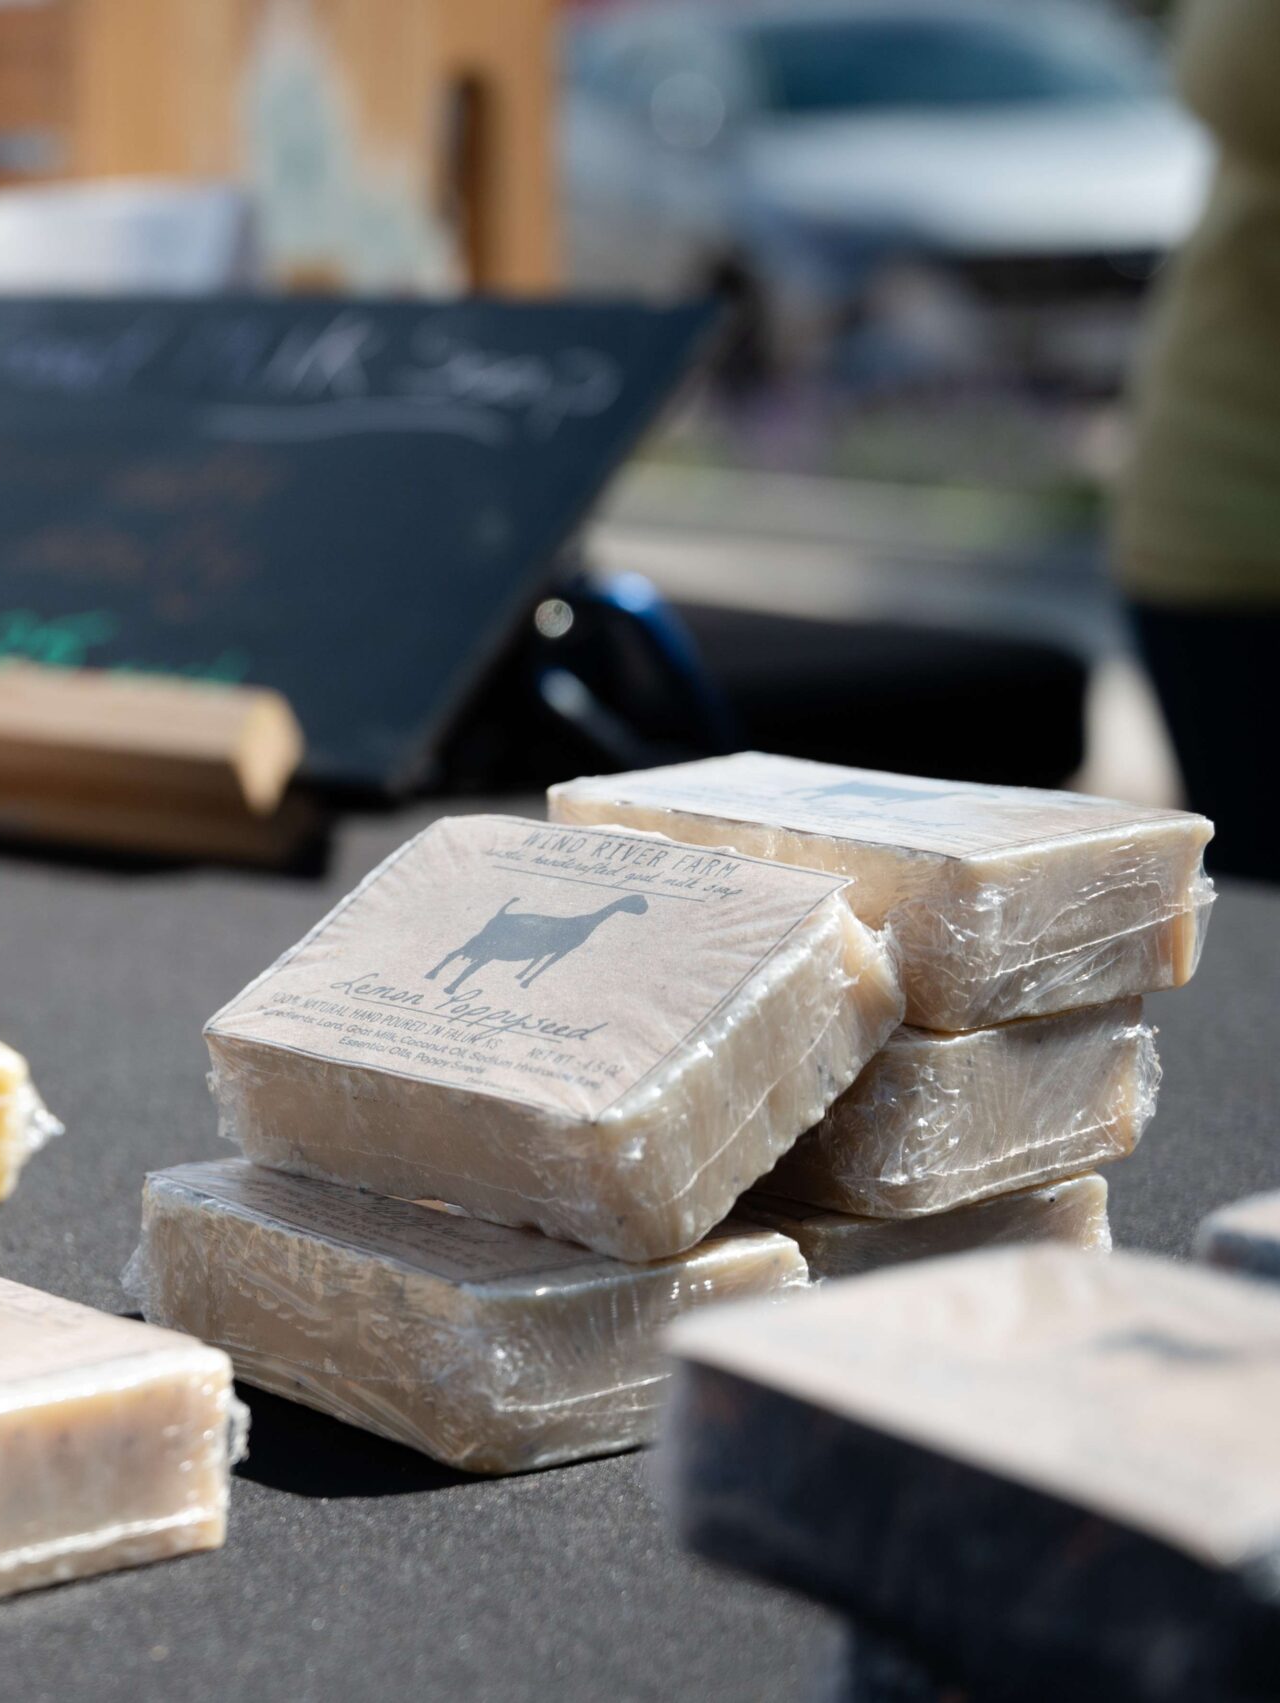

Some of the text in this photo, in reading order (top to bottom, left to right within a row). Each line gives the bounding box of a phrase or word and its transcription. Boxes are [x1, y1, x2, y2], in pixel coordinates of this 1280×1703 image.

[522, 831, 742, 879] WIND RIVER FARM
[530, 853, 627, 877] handcrafted
[611, 870, 665, 889] goat
[662, 877, 703, 890] milk
[703, 883, 743, 900] soap
[329, 972, 424, 1005] Lemon
[303, 998, 349, 1017] NATURAL
[348, 1007, 383, 1024] HAND
[382, 1013, 427, 1033] POURED
[423, 1022, 445, 1036] IN
[481, 1037, 504, 1050] KS
[345, 1023, 371, 1037] Goat
[400, 1035, 449, 1053] Coconut
[338, 1036, 389, 1053] Essential
[412, 1052, 450, 1068] Poppy
